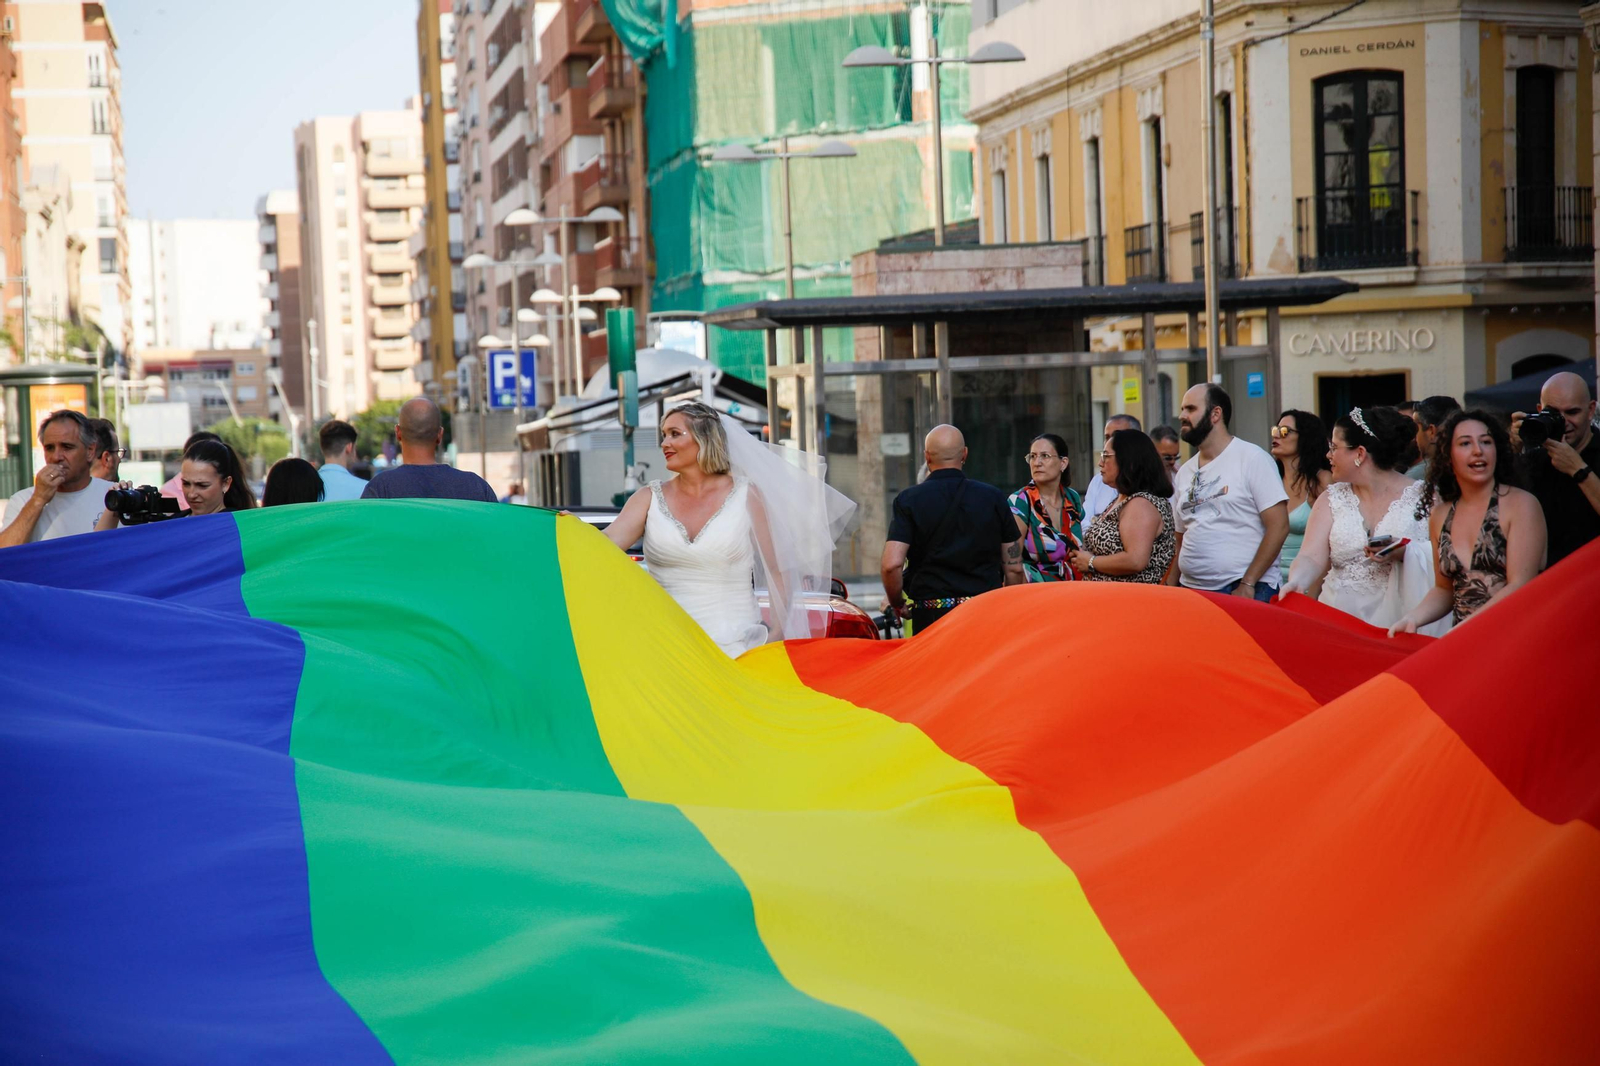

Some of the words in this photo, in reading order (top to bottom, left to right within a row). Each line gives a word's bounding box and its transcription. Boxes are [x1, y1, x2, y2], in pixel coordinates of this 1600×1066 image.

[1300, 45, 1351, 57] DANIEL
[1356, 38, 1415, 53] CERDÁN
[1288, 326, 1435, 362] CAMERINO
[493, 353, 518, 390] P
